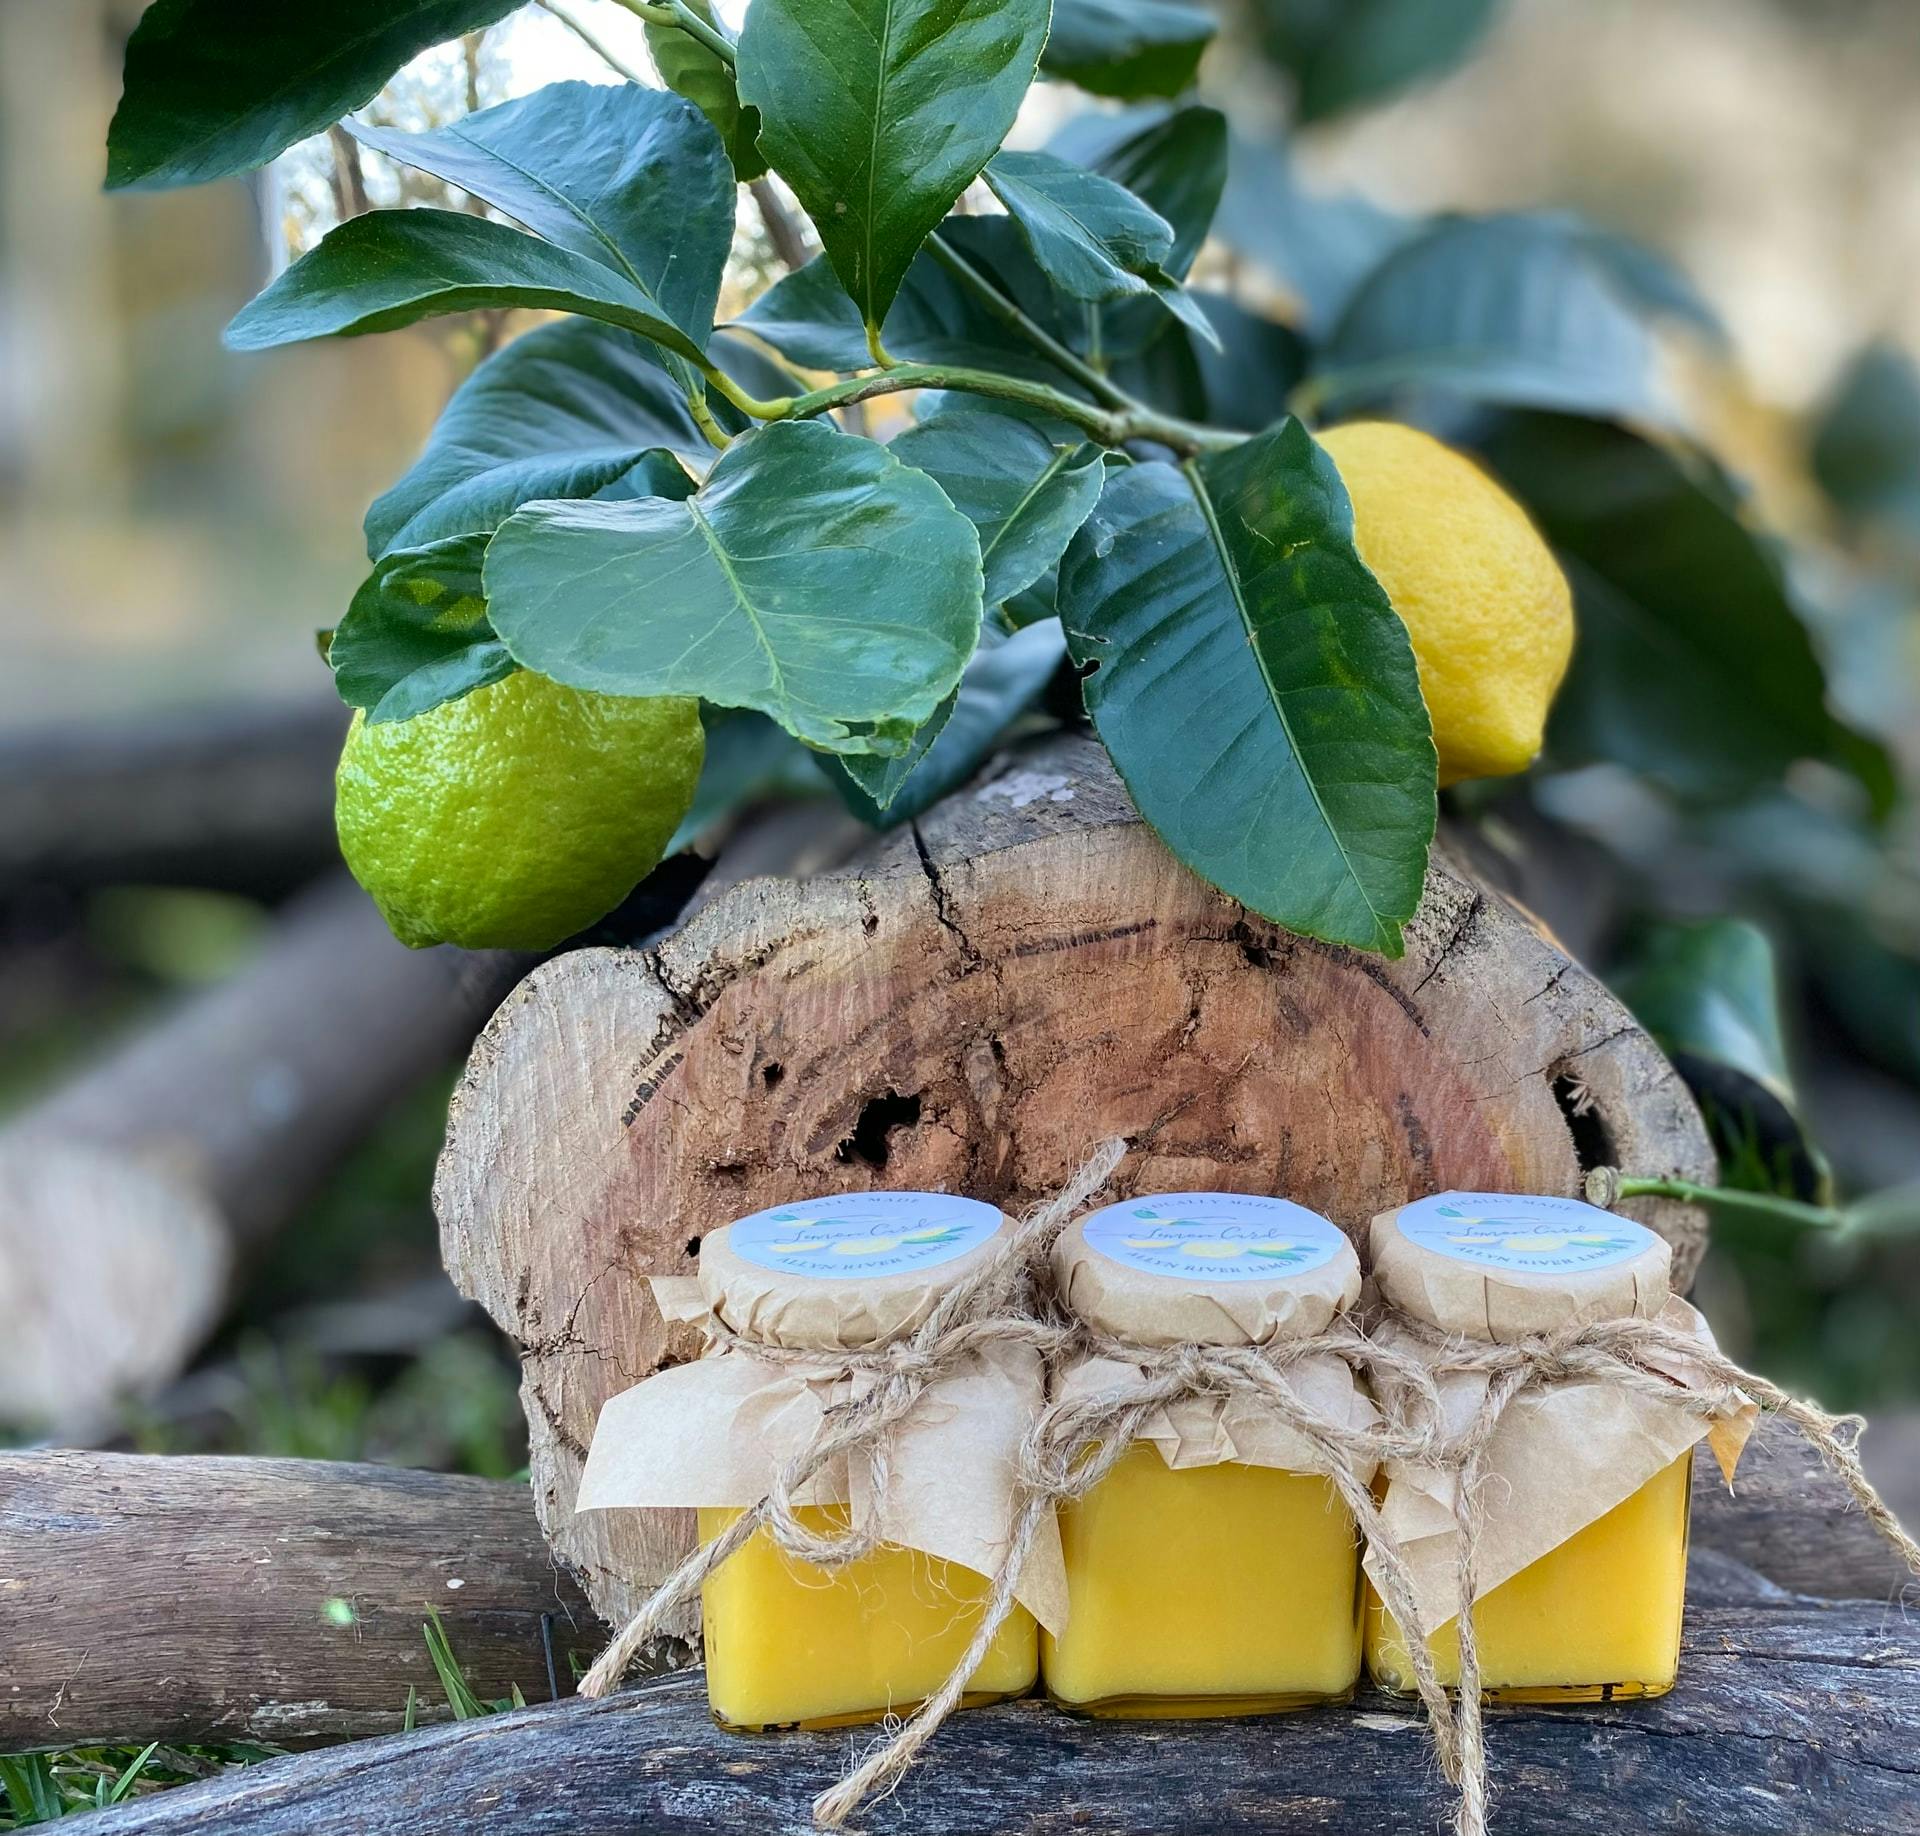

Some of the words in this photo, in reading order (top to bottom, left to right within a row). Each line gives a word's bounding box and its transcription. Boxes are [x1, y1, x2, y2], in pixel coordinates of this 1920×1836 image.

[867, 1196, 920, 1204] MADE
[1230, 1199, 1280, 1210] MADE
[1521, 1199, 1571, 1212] MADE
[1124, 1251, 1180, 1269] ALLYN
[1183, 1263, 1241, 1274] RIVER
[1453, 1246, 1512, 1263] ALLYN
[1517, 1258, 1575, 1266] RIVER
[842, 1257, 903, 1271] RIVER
